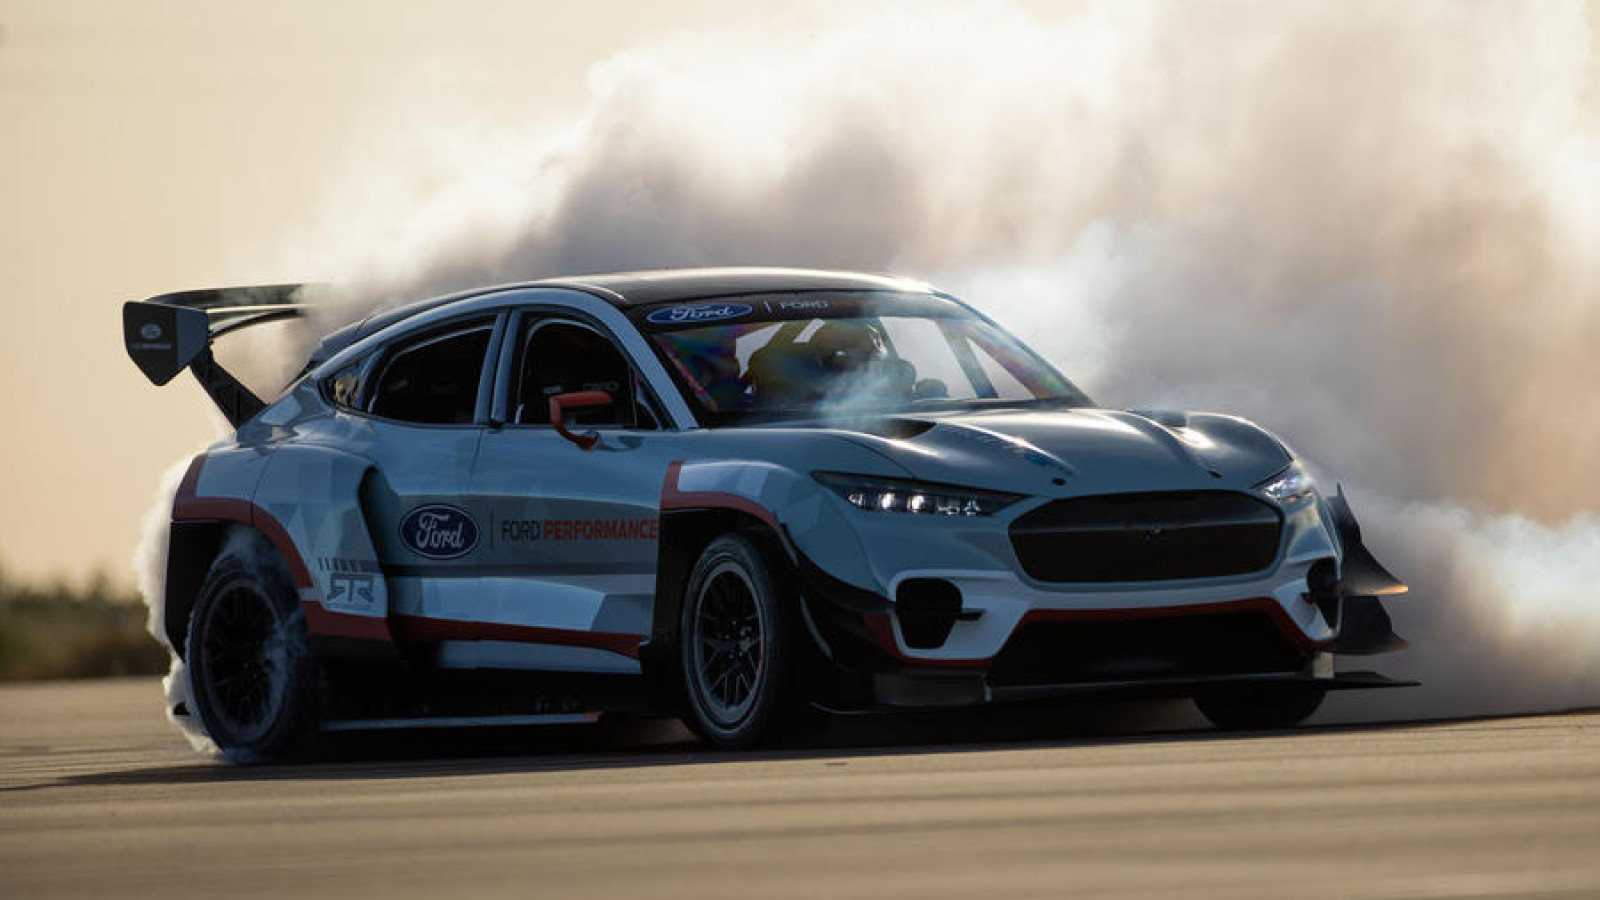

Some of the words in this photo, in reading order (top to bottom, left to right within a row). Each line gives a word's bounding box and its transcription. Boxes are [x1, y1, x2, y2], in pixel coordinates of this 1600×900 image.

[669, 304, 731, 321] Ford
[778, 300, 830, 310] FORD
[415, 511, 465, 549] Ford
[501, 520, 541, 541] FORD
[542, 518, 658, 541] PERFORMANCE
